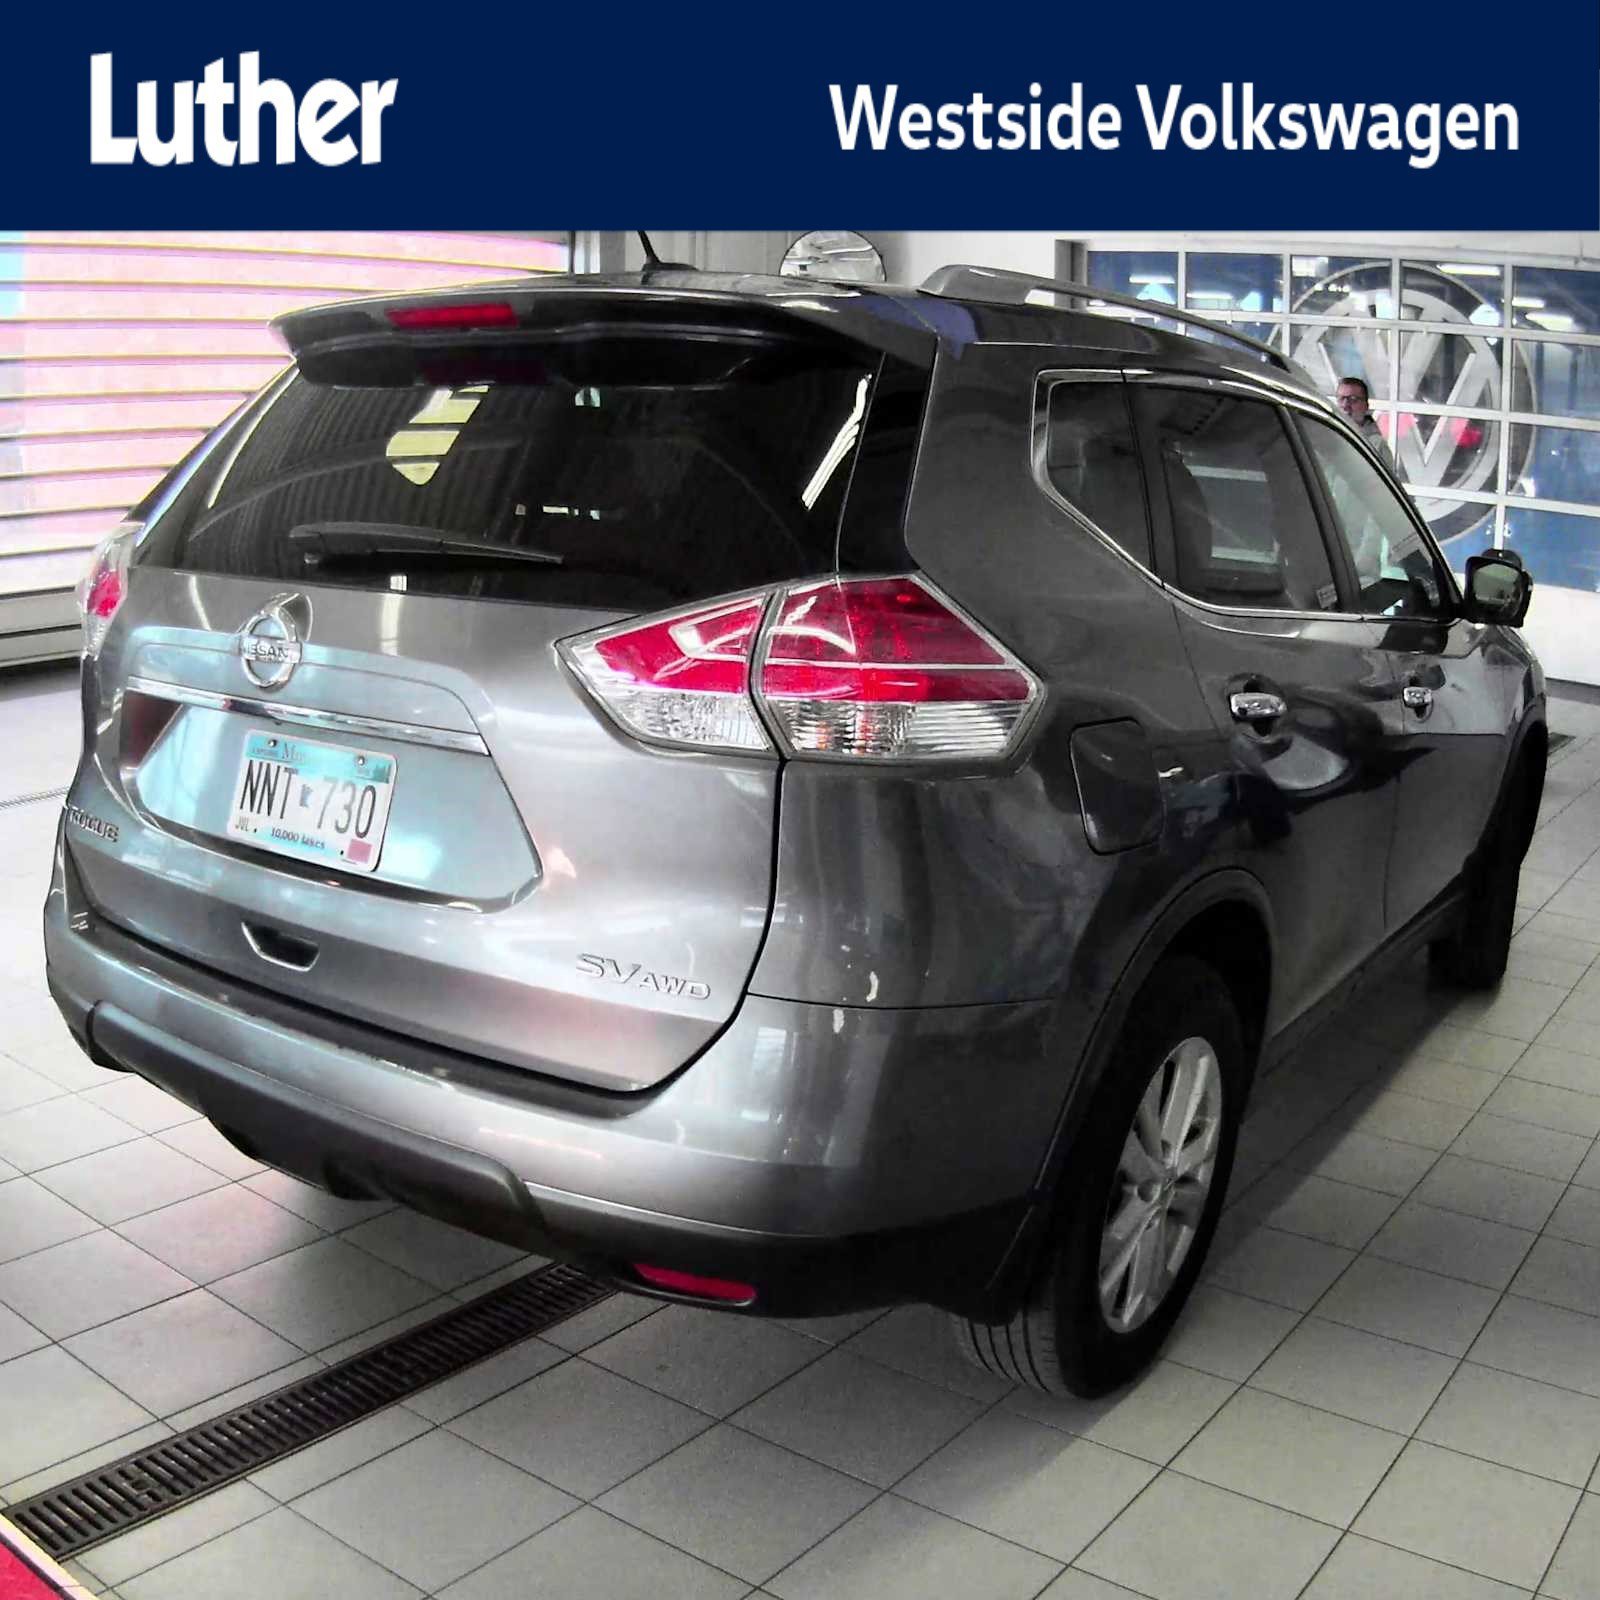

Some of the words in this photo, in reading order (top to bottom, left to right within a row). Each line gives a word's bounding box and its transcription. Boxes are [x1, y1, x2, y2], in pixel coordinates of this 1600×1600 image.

[239, 759, 299, 820] NNT
[316, 775, 377, 839] 730
[576, 953, 642, 984] SV
[639, 971, 711, 1001] AWD
